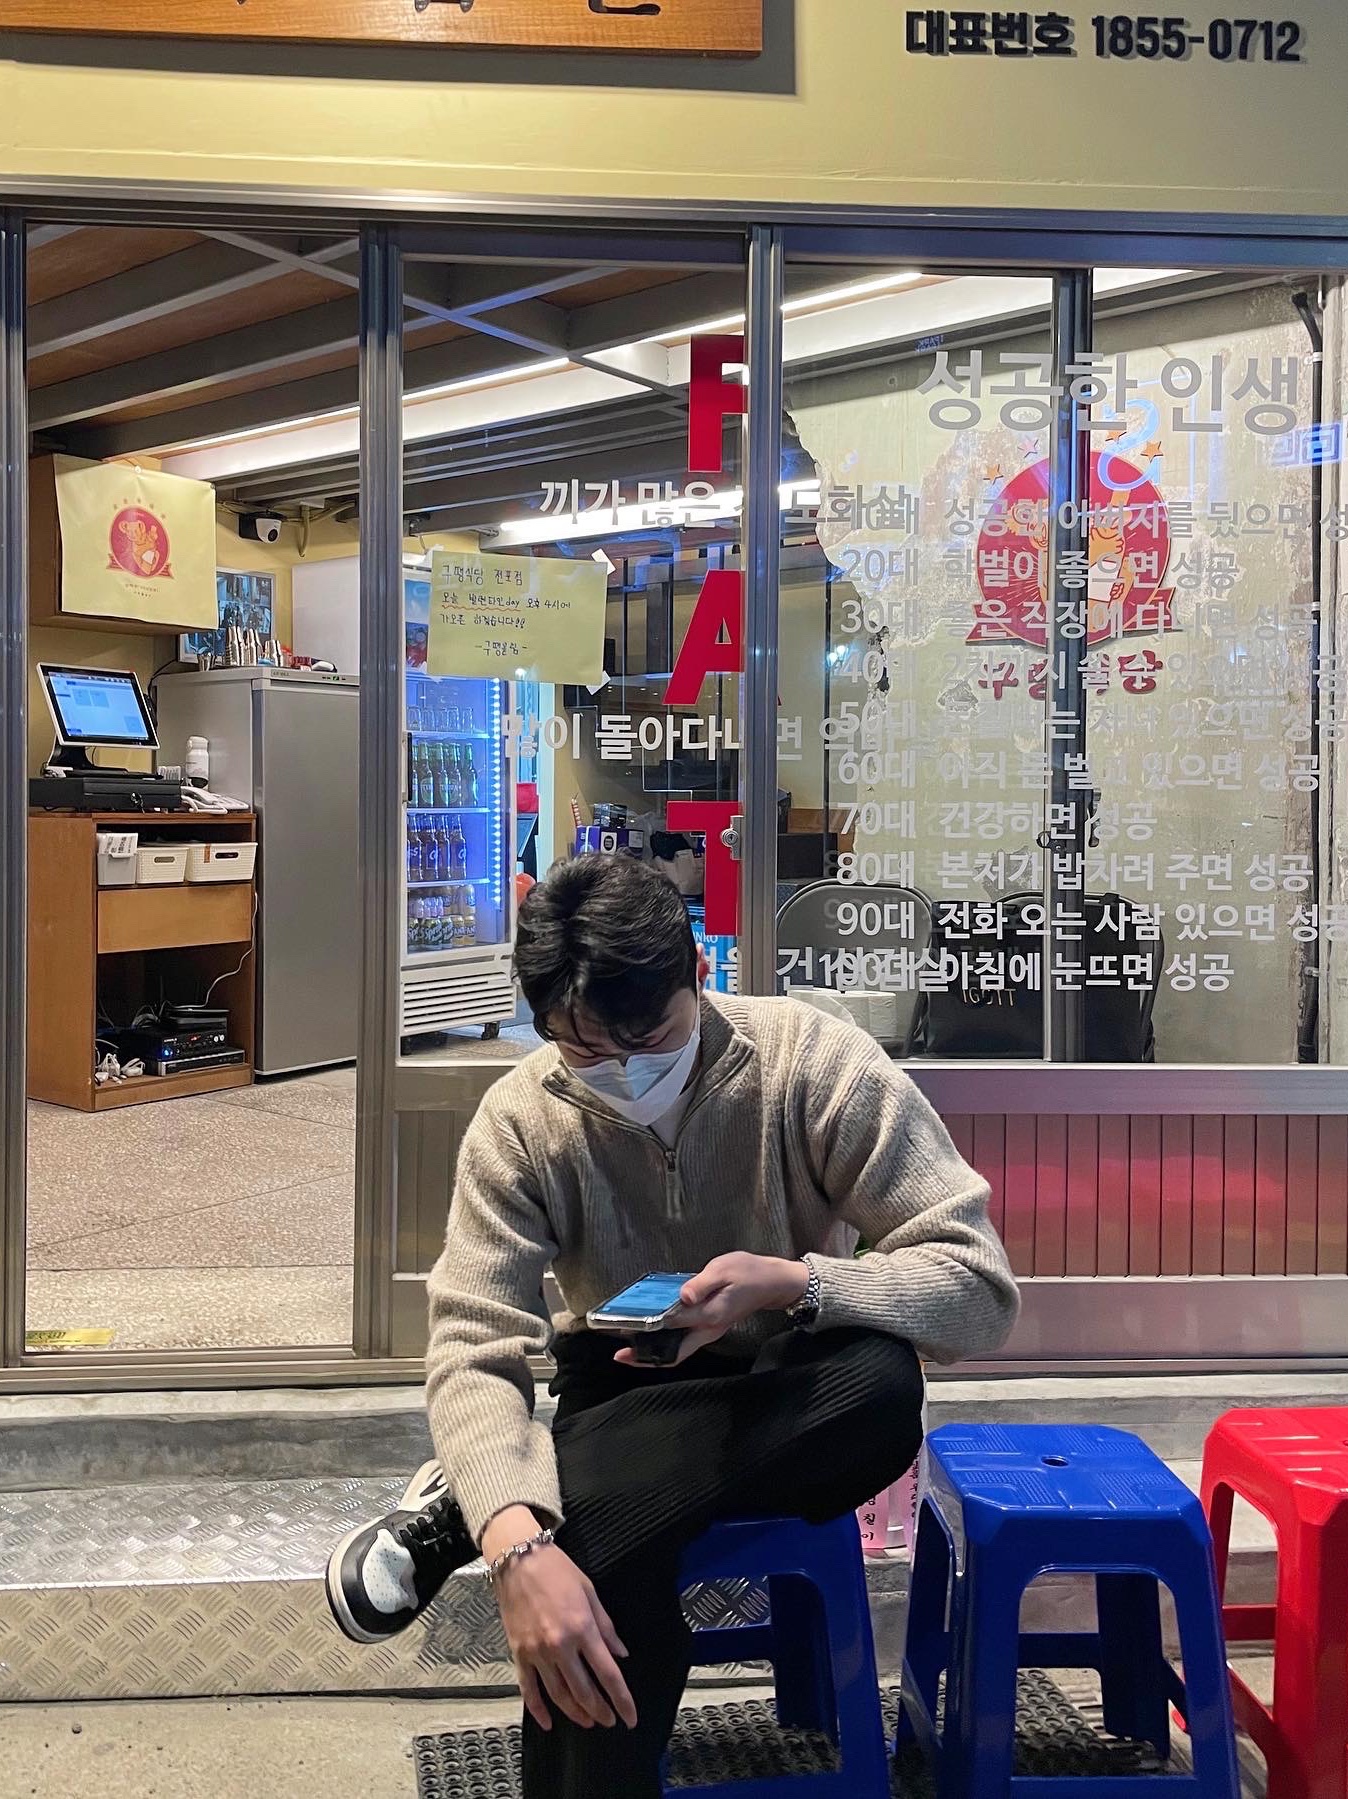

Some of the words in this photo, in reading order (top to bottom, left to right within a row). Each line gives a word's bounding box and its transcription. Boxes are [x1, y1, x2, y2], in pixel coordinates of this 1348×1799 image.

[905, 10, 1074, 55] 대표번호
[1092, 15, 1303, 62] 1855-0712
[916, 348, 1139, 433] 성공한
[1160, 354, 1300, 435] 인생
[538, 479, 626, 527] 끼가
[636, 480, 720, 529] 많은
[944, 498, 1044, 538] 성공한
[1057, 498, 1198, 540] 아버지를
[842, 548, 920, 587] 20대
[942, 548, 1044, 589] 학벌이
[1055, 550, 1159, 590] 좋으면
[1171, 551, 1240, 591] 성공
[440, 613, 466, 627] 가오픈
[442, 591, 459, 605] 오늘
[525, 597, 540, 610] 오후
[544, 599, 571, 610] 4시에
[840, 600, 917, 637] 30대
[1020, 600, 1123, 640] 직장에
[501, 712, 581, 760] 많이
[838, 750, 916, 789] 60대
[939, 750, 1006, 790] 아직
[1142, 752, 1243, 791] 있으면
[1254, 753, 1321, 793] 성공
[837, 800, 915, 839] 70대
[938, 800, 1077, 841] 건강하면
[1085, 802, 1158, 841] 성공
[836, 850, 915, 890] 80대
[938, 850, 1044, 890] 본처가
[1053, 852, 1154, 891] 밥차려
[1165, 852, 1233, 892] 주면
[1244, 852, 1314, 892] 성공
[836, 900, 915, 940] 90대
[937, 901, 1009, 941] 전화
[1016, 902, 1087, 941] 오는
[1094, 902, 1166, 941] 사람
[1174, 903, 1276, 942] 있으면
[940, 951, 1042, 992] 아침에
[1051, 952, 1154, 992] 눈뜨면
[1165, 952, 1235, 992] 성공
